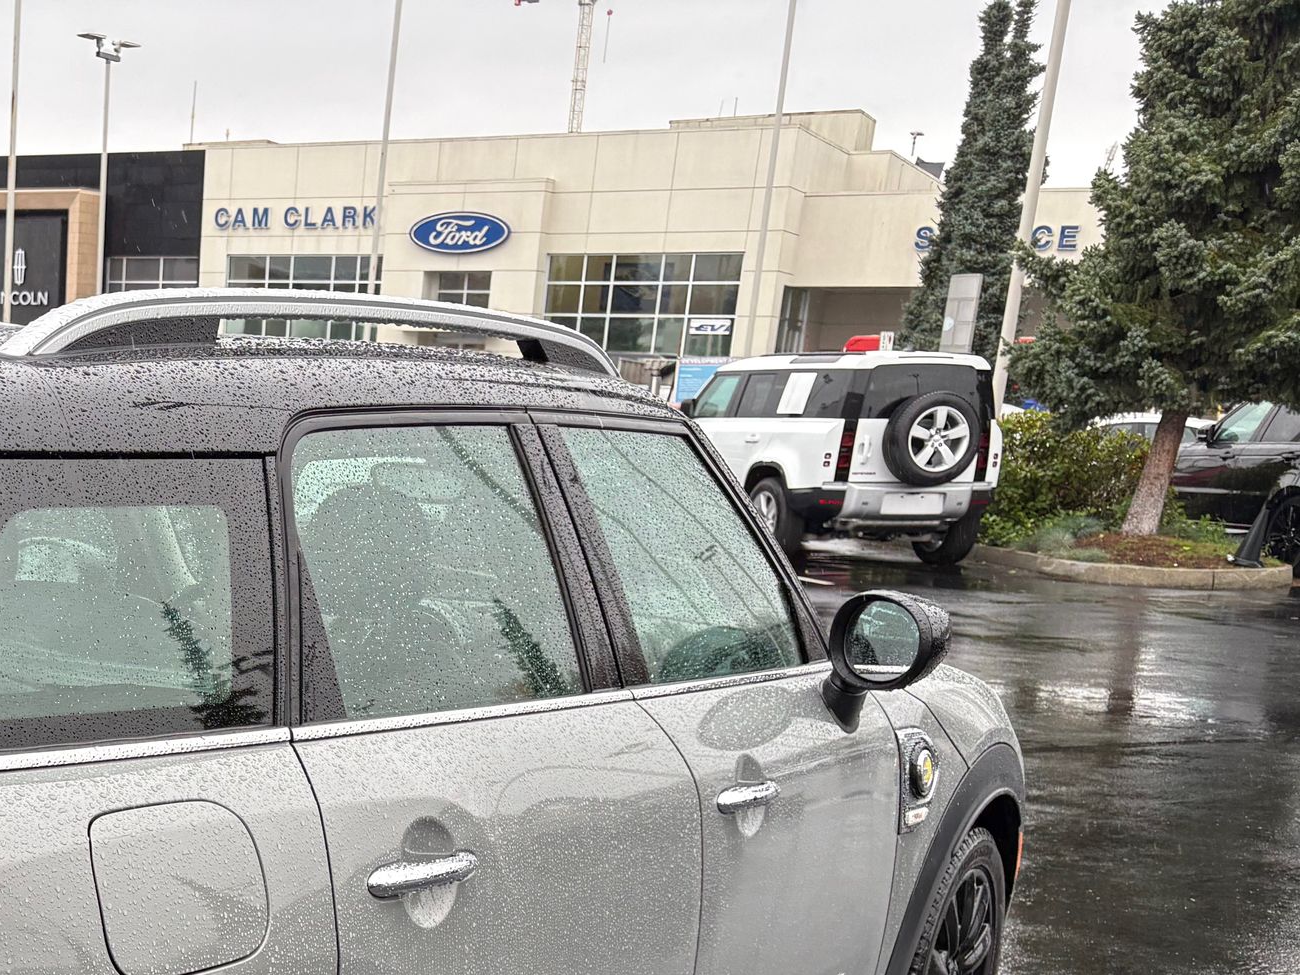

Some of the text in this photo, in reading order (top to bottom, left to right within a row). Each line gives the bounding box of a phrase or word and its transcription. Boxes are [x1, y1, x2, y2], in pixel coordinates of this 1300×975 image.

[215, 206, 377, 229] CAM CLARK
[428, 219, 490, 246] Ford
